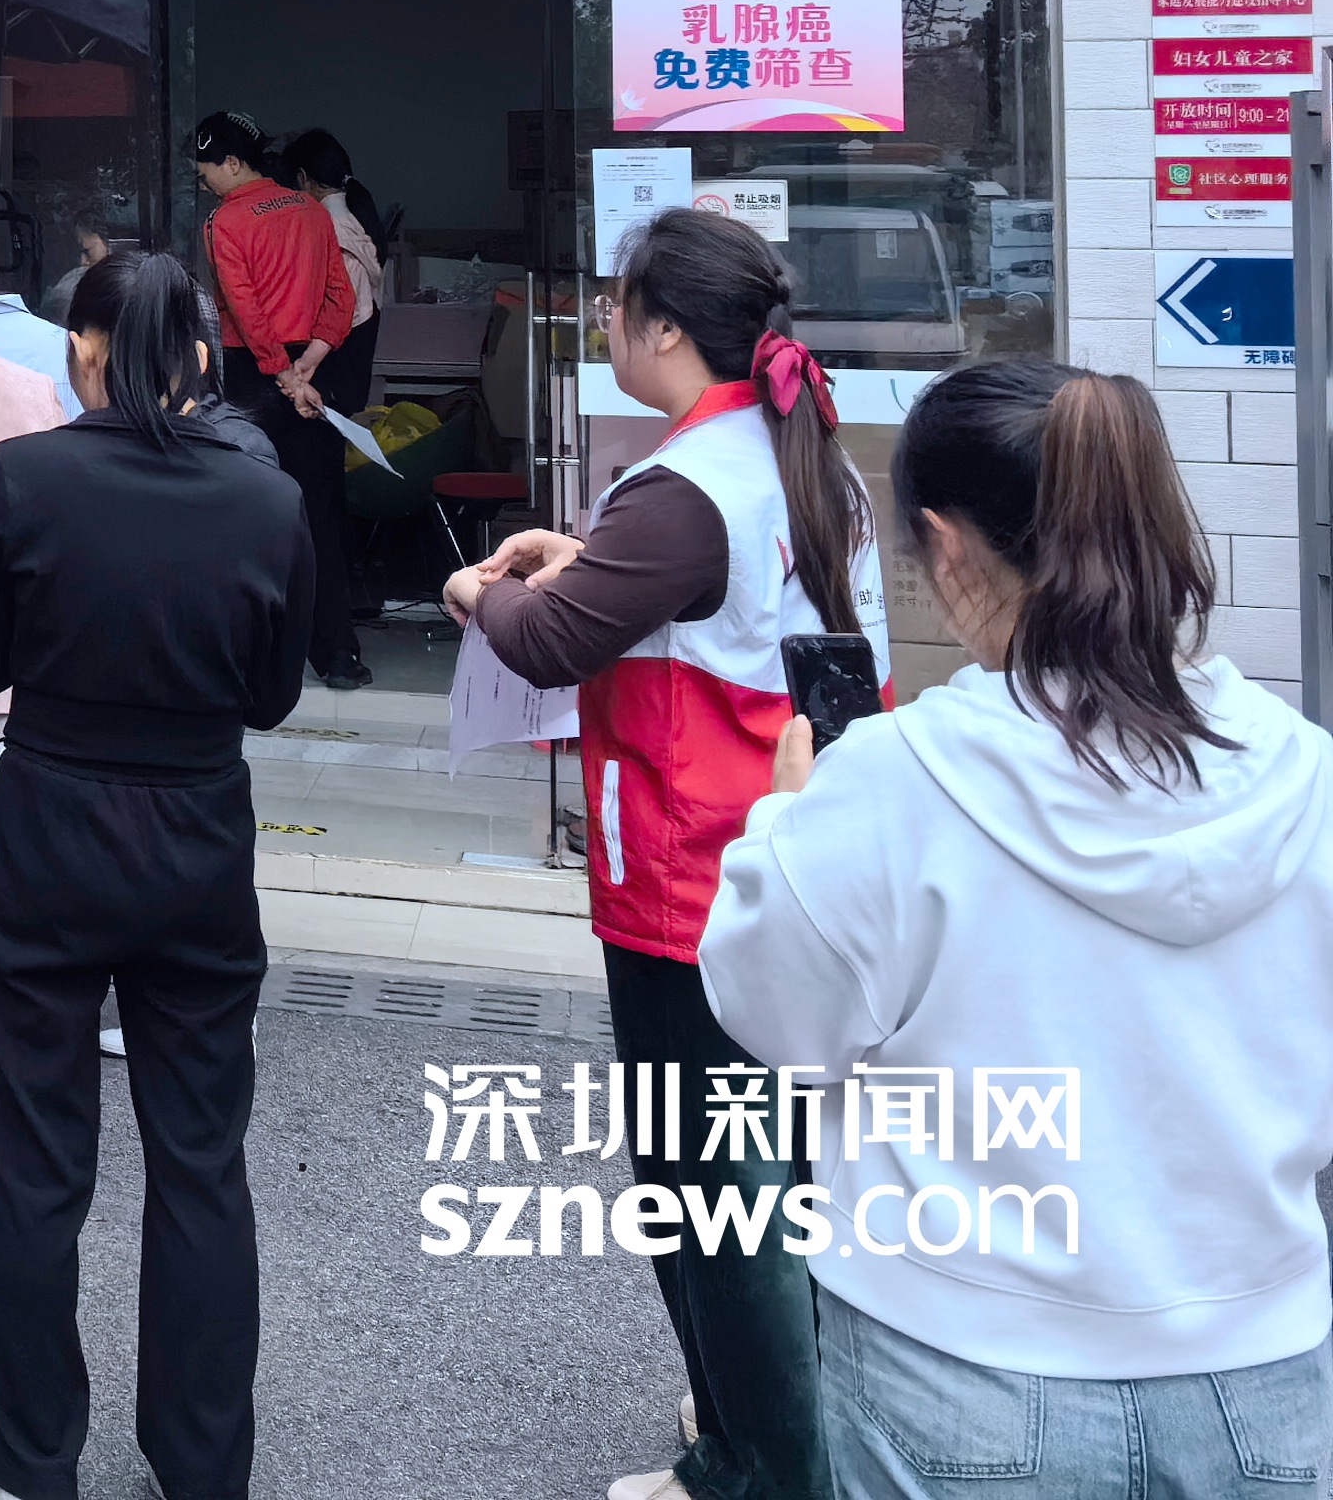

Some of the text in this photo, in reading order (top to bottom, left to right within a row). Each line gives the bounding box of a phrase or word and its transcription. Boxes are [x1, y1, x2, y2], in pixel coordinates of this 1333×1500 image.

[682, 2, 832, 44] 乳腺癌
[1173, 49, 1294, 68] 妇女儿童之家
[653, 48, 853, 90] 免费筛查
[1163, 102, 1232, 119] 开放时间
[1238, 108, 1264, 123] 9:00
[734, 193, 781, 203] 禁止吸烟
